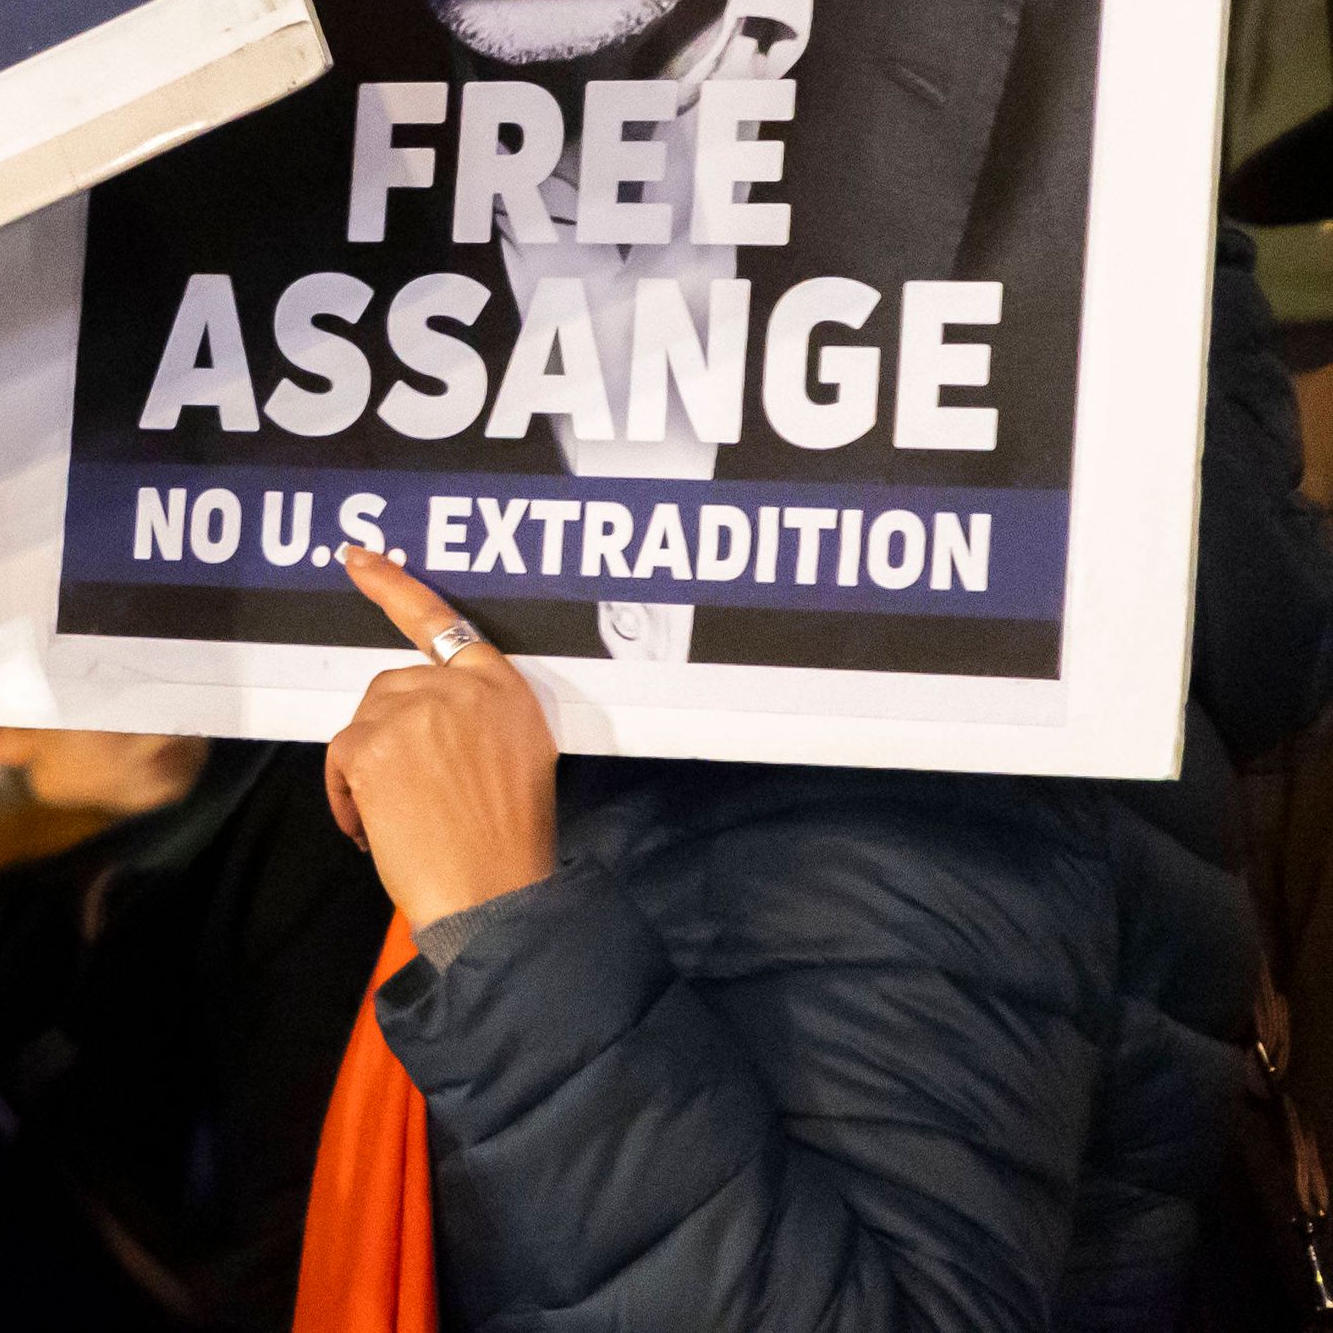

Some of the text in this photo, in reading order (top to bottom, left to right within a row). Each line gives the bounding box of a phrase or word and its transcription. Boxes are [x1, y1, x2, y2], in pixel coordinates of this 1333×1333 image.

[345, 78, 797, 246] FREE
[137, 271, 1004, 451] ASSANGE
[134, 487, 992, 592] NO U.S. EXTRADITION
